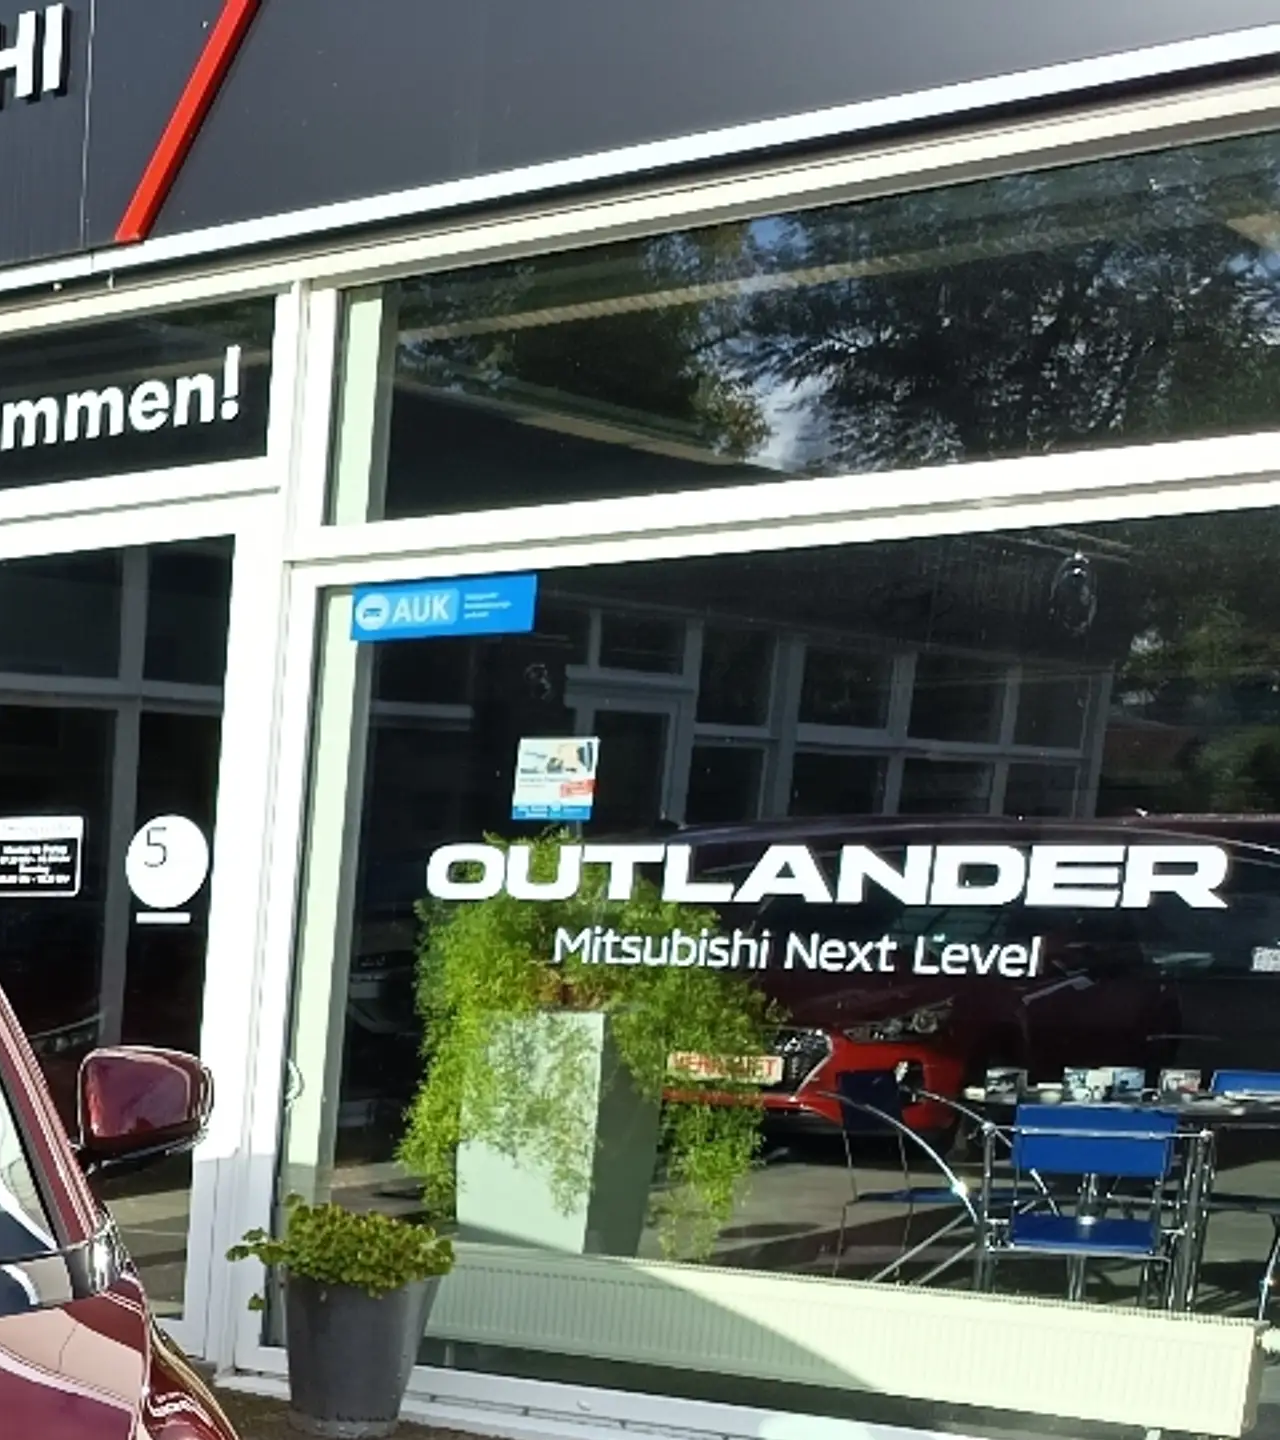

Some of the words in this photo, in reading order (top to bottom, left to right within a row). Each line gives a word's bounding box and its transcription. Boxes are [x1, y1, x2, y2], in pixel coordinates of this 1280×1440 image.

[391, 592, 451, 625] AUK
[143, 825, 168, 869] 5
[425, 844, 1228, 909] OUTLANDER
[552, 925, 772, 970] Mitsubishi
[783, 931, 896, 974] Next
[913, 934, 1042, 979] Level
